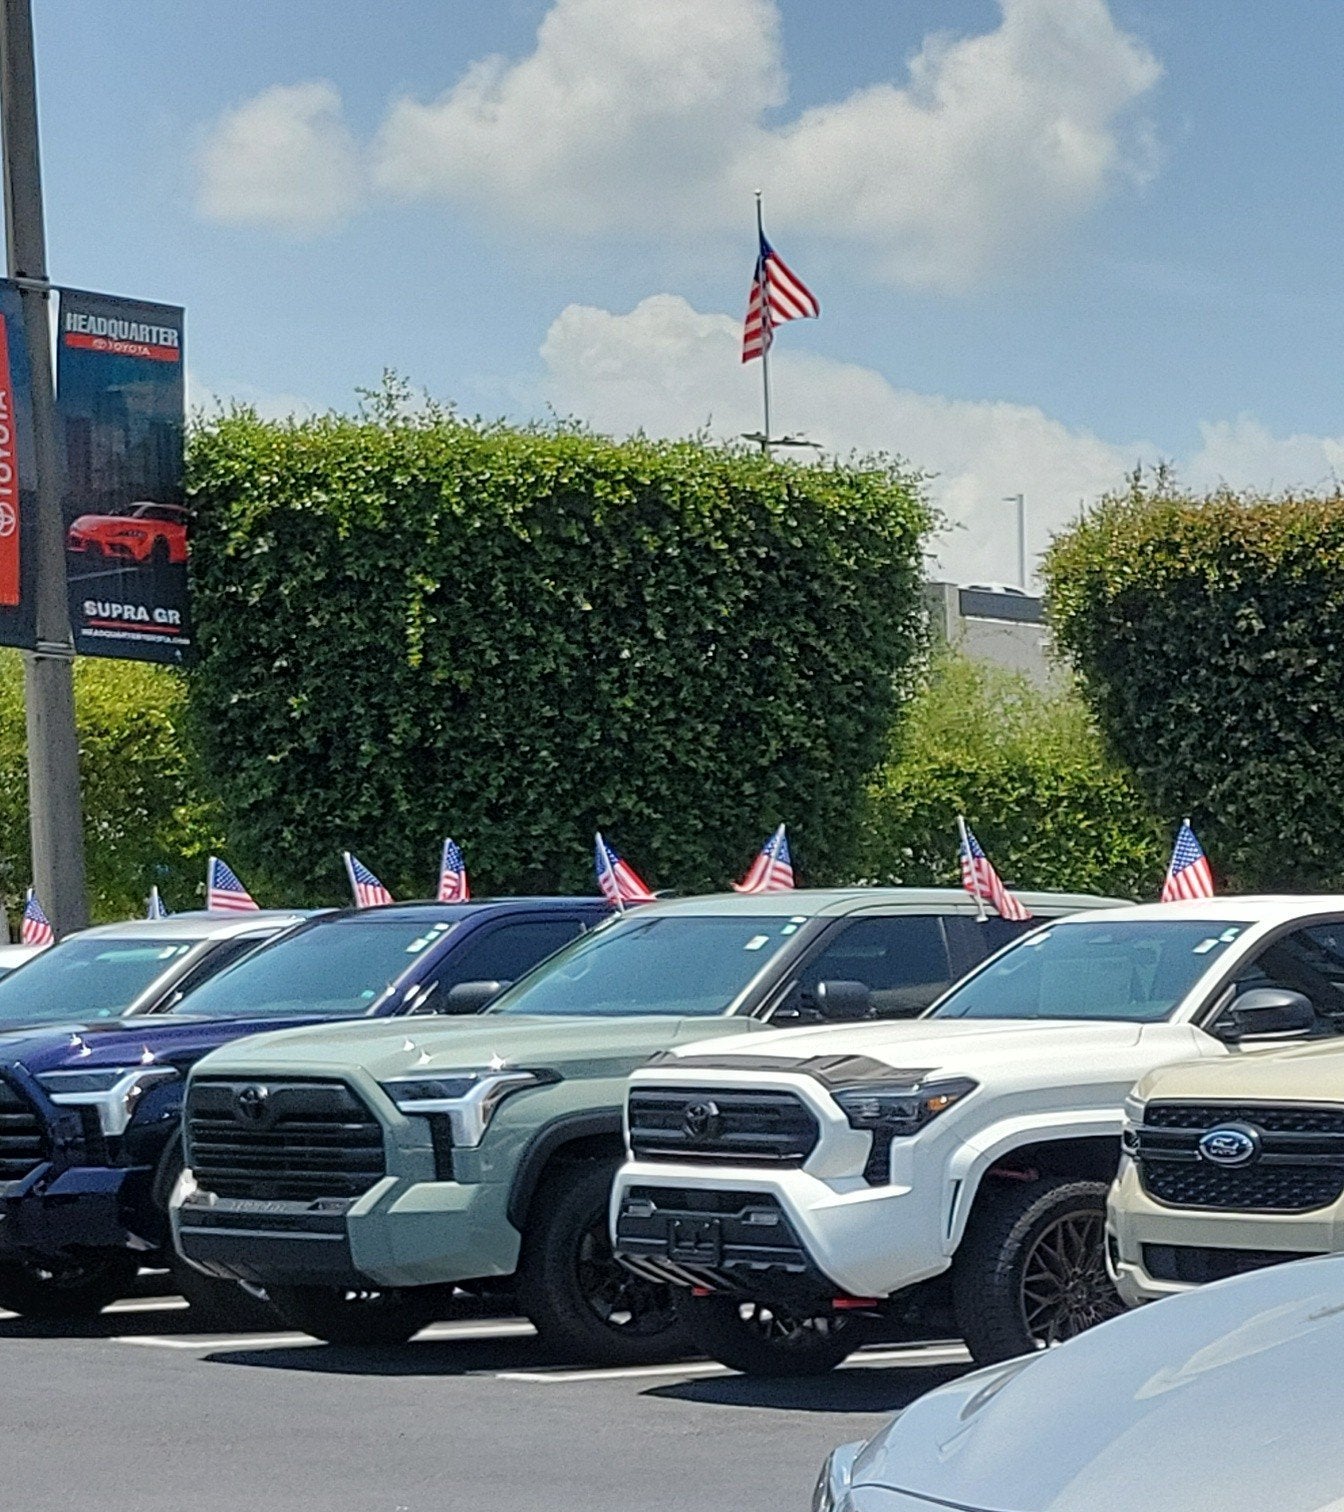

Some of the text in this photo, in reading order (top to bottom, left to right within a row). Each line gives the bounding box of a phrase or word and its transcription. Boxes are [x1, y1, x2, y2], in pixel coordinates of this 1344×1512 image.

[66, 312, 179, 348] HEADQUARTER
[108, 339, 151, 356] TOYOTA
[83, 600, 181, 625] SUPRA GR
